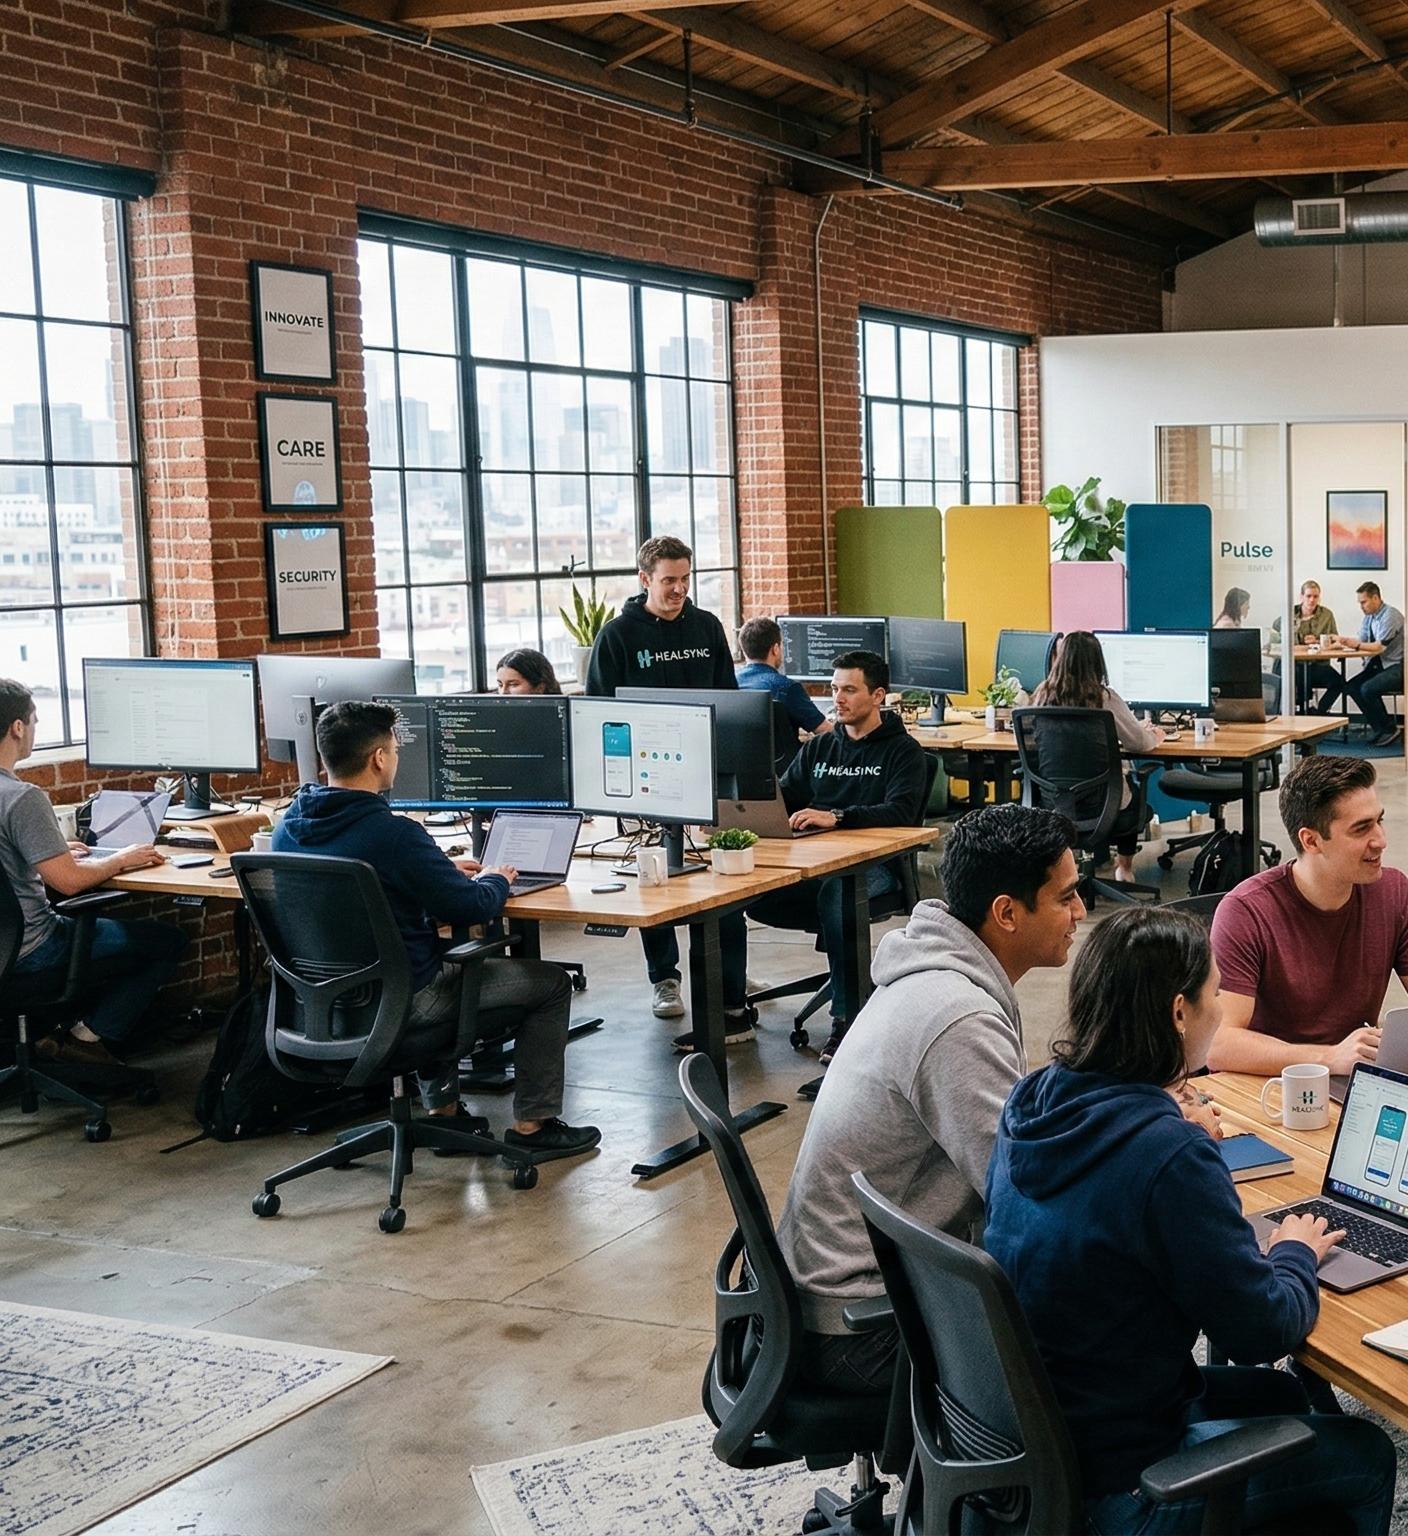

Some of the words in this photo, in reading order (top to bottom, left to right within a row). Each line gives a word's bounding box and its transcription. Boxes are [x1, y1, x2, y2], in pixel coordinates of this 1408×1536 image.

[265, 310, 324, 328] INNOVATE
[277, 439, 326, 458] CARE
[1220, 541, 1273, 558] Pulse
[279, 569, 337, 584] SECURITY
[655, 648, 710, 662] HEALSYNC
